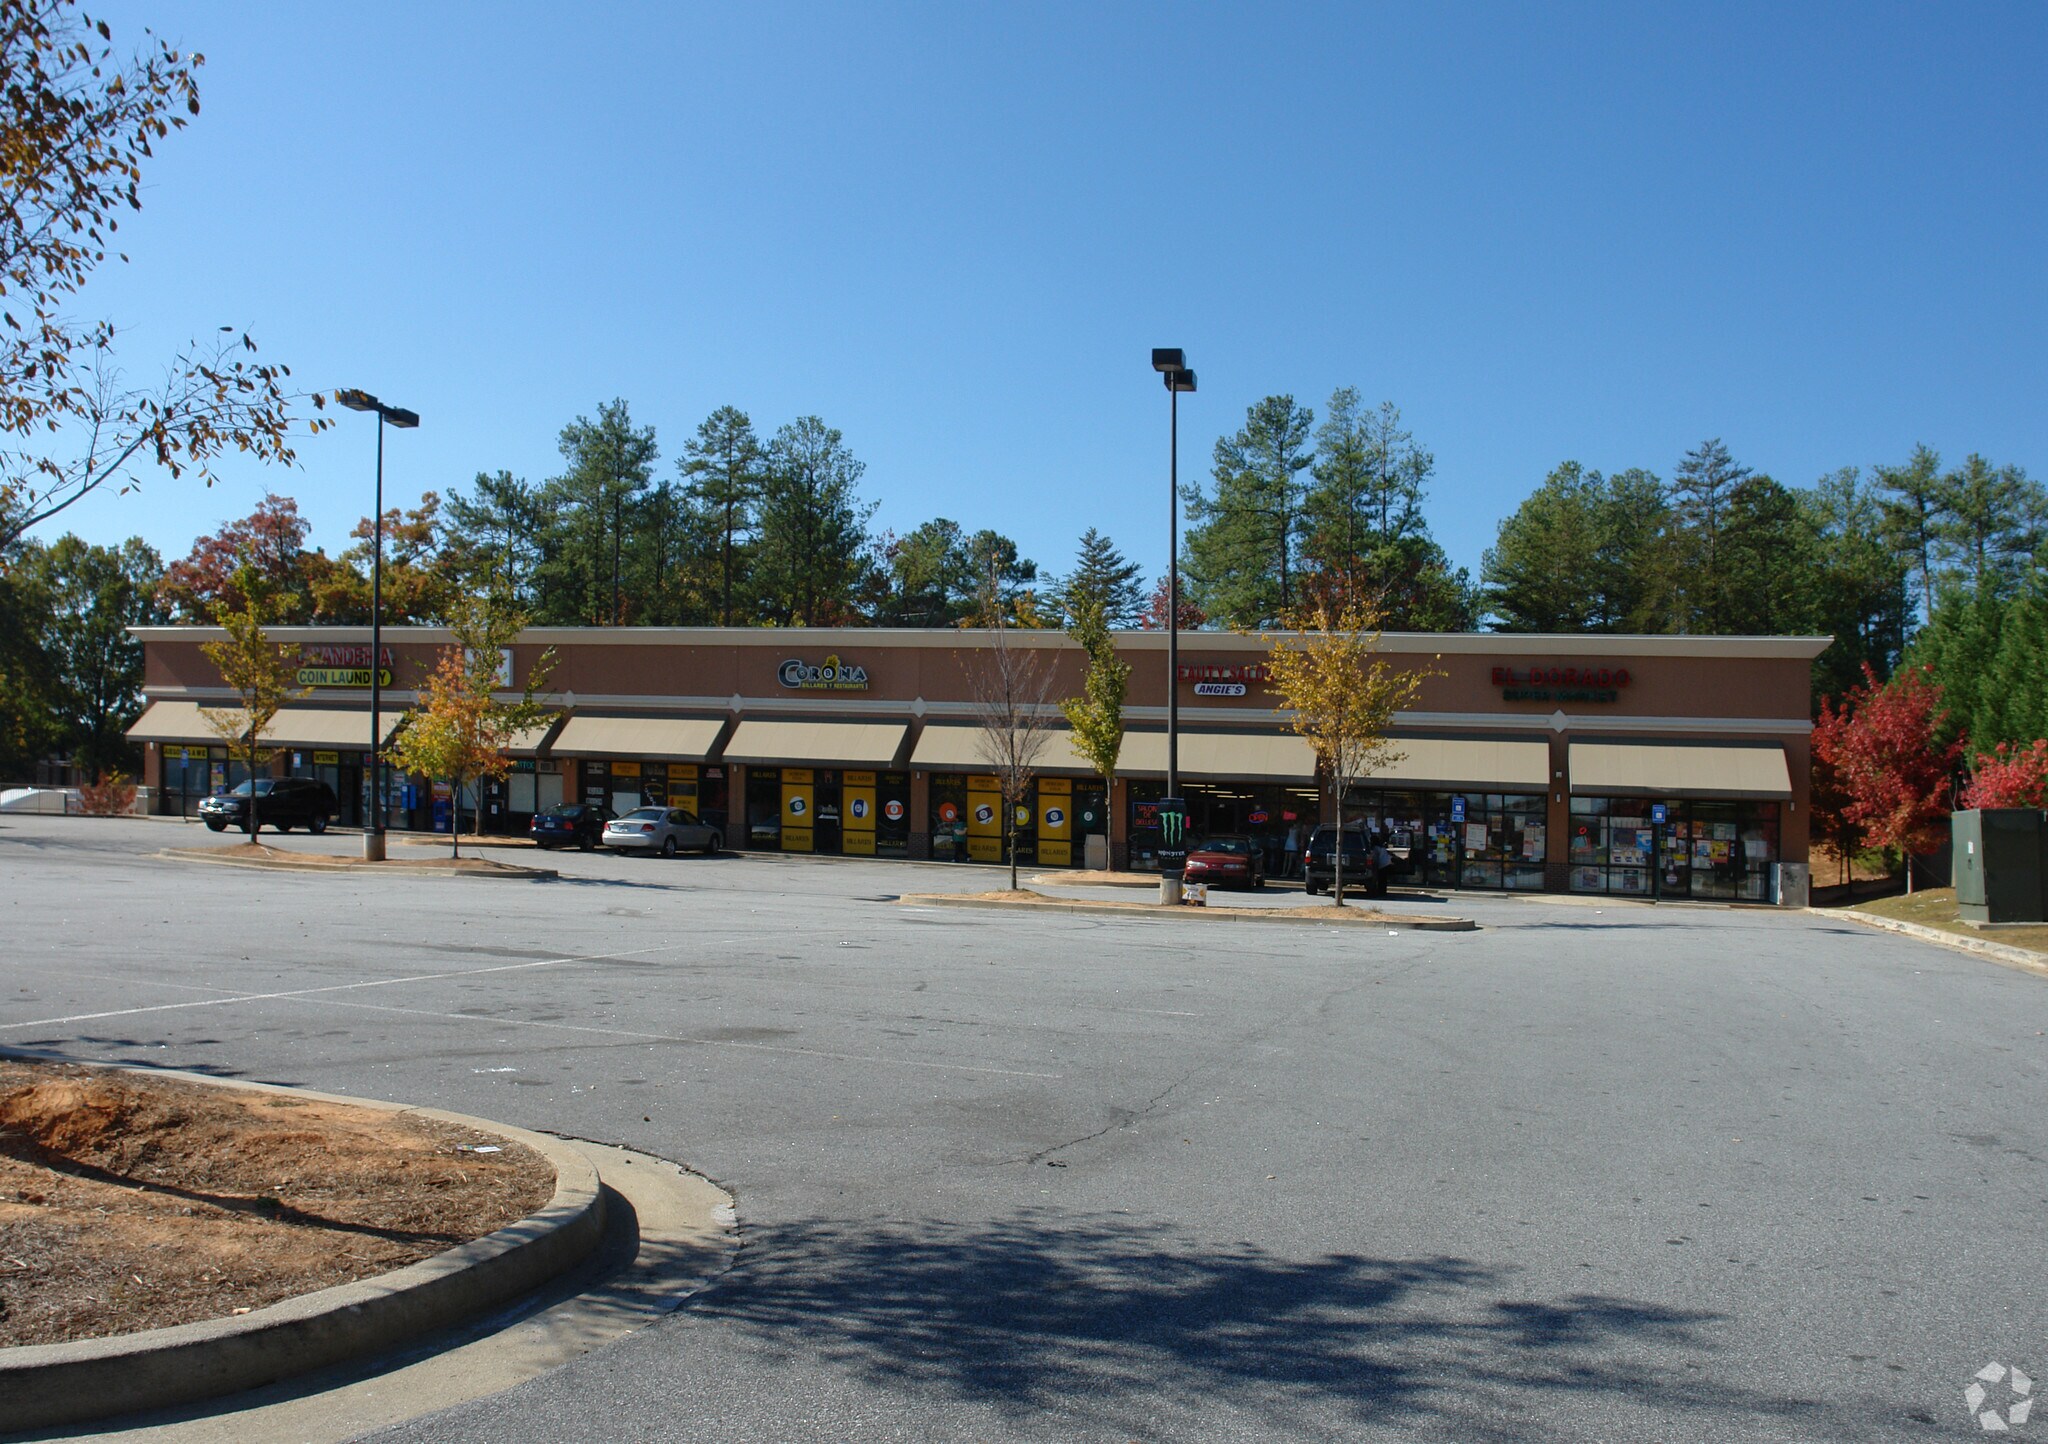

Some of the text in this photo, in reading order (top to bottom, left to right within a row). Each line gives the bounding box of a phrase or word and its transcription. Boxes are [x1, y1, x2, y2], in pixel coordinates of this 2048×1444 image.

[300, 671, 386, 684] COIN LAUNDY
[778, 659, 868, 689] CORONA
[1177, 665, 1224, 682] EAUTY
[1492, 667, 1631, 688] EL DORADO
[1198, 685, 1243, 695] ANGIE'S
